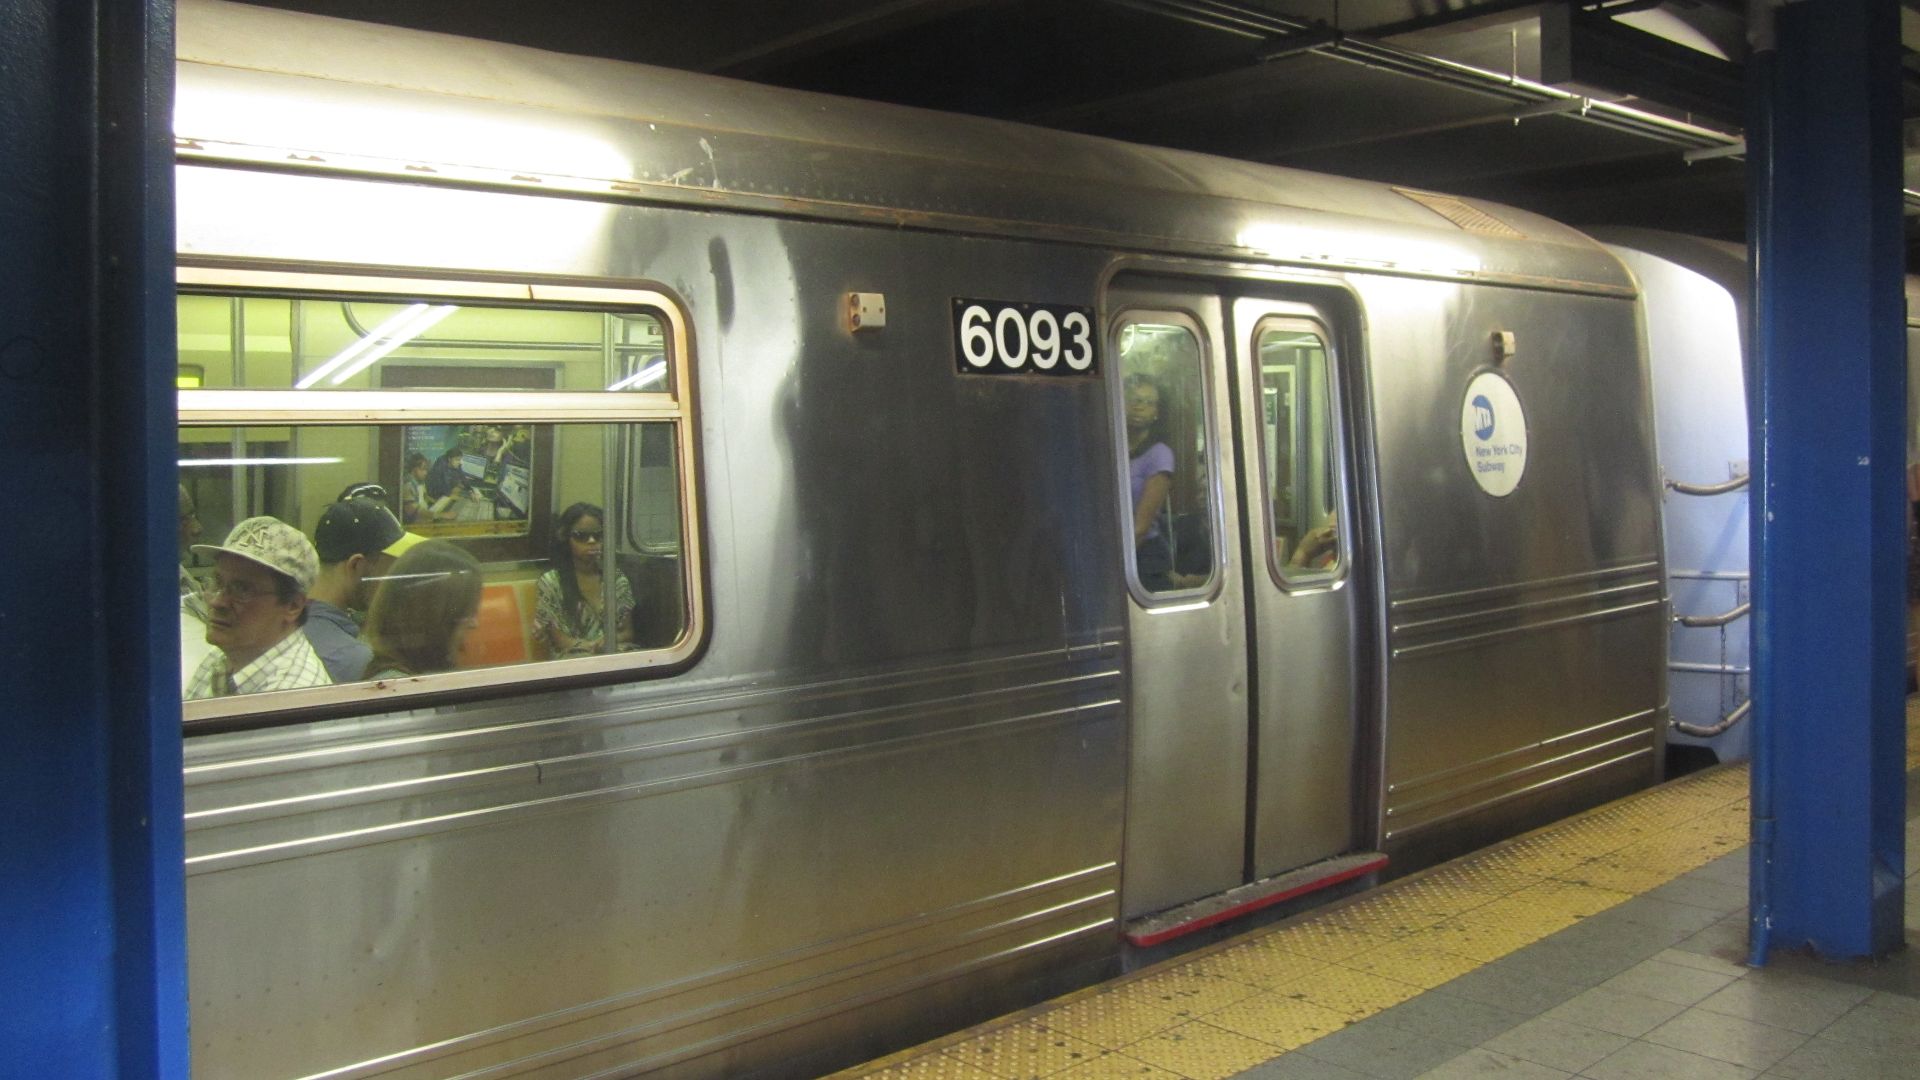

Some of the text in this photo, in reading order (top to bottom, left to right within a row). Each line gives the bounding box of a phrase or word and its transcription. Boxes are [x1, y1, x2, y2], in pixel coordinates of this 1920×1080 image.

[960, 305, 1093, 370] 6093
[1475, 443, 1523, 457] New York City
[1477, 461, 1505, 473] Subway
